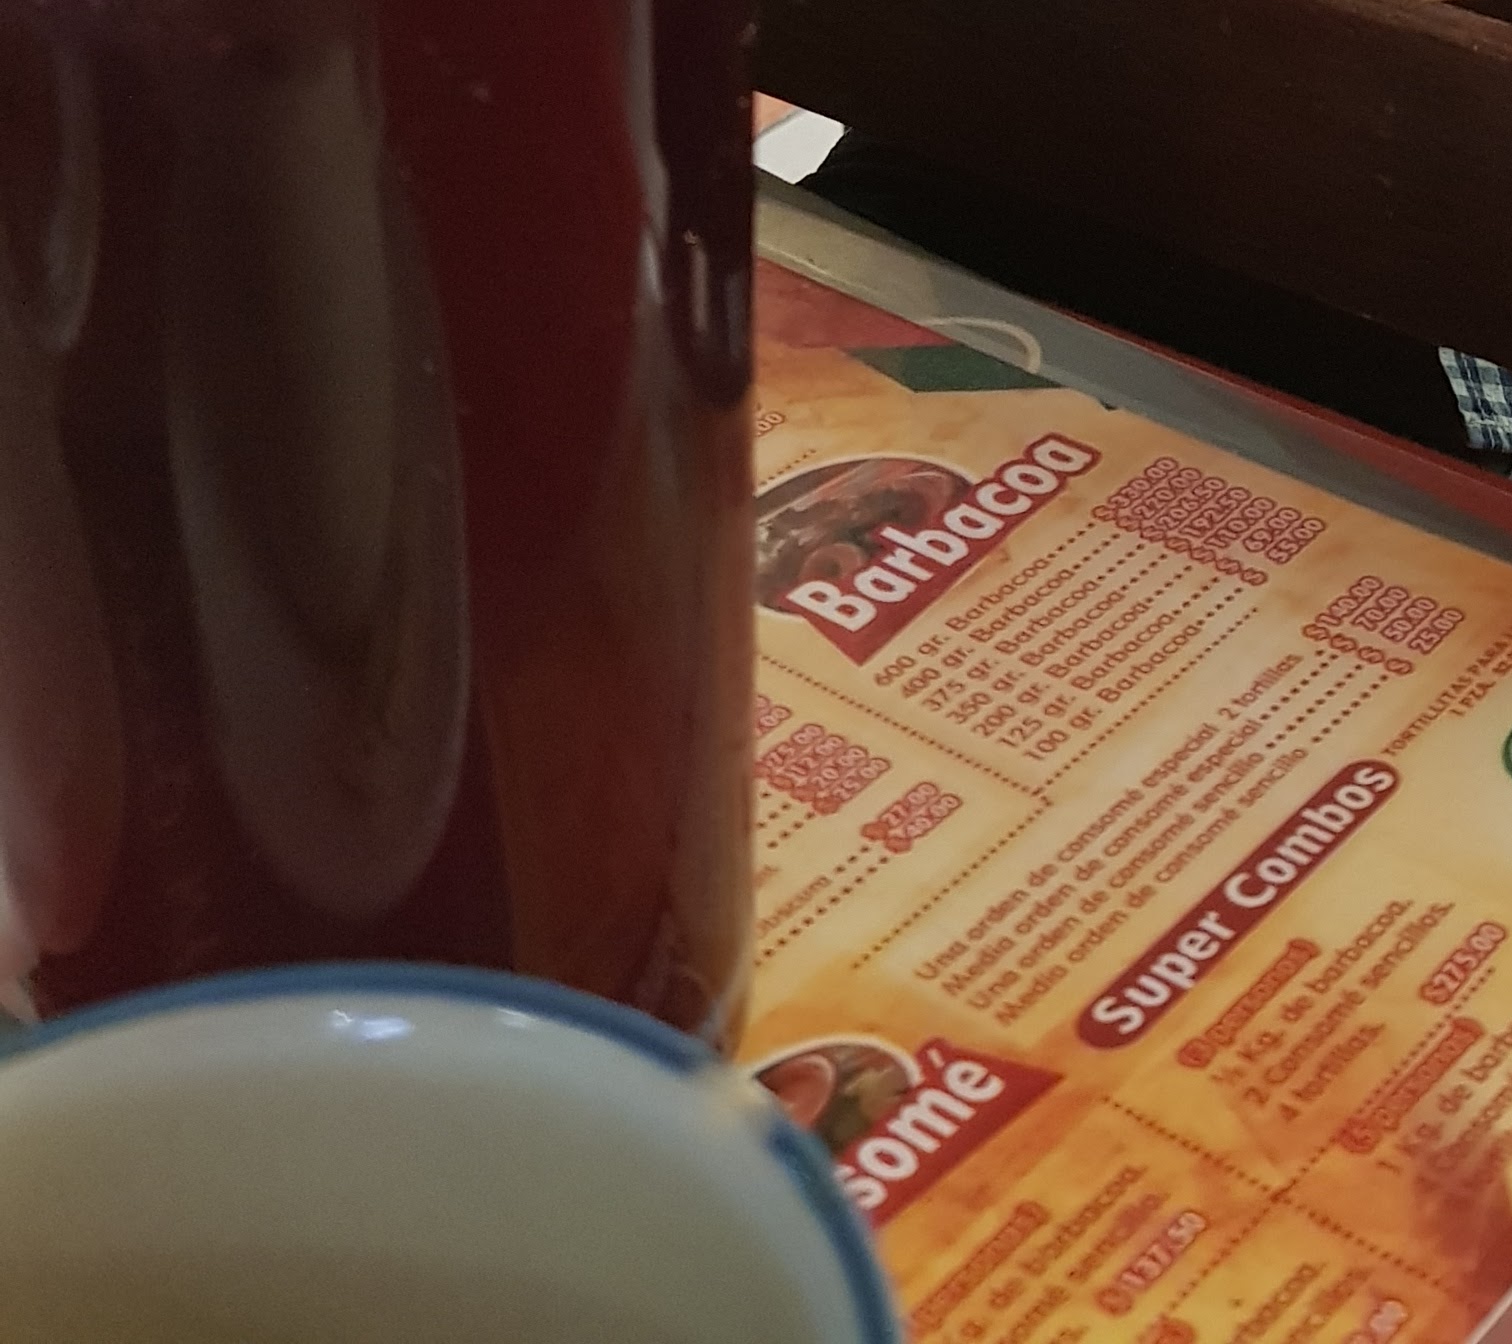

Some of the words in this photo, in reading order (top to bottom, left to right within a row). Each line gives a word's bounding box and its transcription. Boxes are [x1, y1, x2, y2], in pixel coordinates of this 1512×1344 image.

[786, 438, 1094, 632] Barbacoa
[873, 655, 916, 687] 600
[918, 634, 951, 657] gr.
[945, 559, 1049, 632] Barbacoa
[902, 666, 941, 698] 400
[941, 646, 975, 669] gr.
[969, 568, 1075, 643] Barbacoa
[921, 679, 967, 712] 375
[967, 658, 1000, 683] gr.
[995, 579, 1099, 654] Barbacoa
[946, 691, 992, 725] 350
[992, 668, 1027, 693] gr.
[1019, 590, 1125, 668] Barbacoa
[971, 704, 1016, 739] 200
[1016, 682, 1050, 706] gr.
[1044, 602, 1150, 679] Barbacoa
[999, 716, 1044, 749] 125
[1044, 694, 1077, 719] gr.
[1071, 613, 1174, 690] Barbacoa
[1023, 729, 1070, 761] 100
[1070, 704, 1102, 732] gr.
[1097, 625, 1200, 703] Barbacoa
[914, 941, 969, 980] Una
[967, 889, 1029, 941] orden
[1028, 863, 1058, 887] de
[1058, 786, 1144, 863] consomé
[1142, 723, 1219, 789] especial
[1218, 706, 1241, 722] 2
[1231, 654, 1303, 707] tortillas
[942, 936, 1015, 997] Media
[1015, 883, 1076, 935] orden
[1074, 859, 1105, 882] de
[1104, 782, 1188, 858] consomé
[1187, 719, 1263, 783] especial
[1018, 916, 1082, 969] orden
[1079, 890, 1110, 914] de
[1109, 813, 1195, 889] consomé
[1192, 751, 1265, 813] sencillo
[995, 964, 1068, 1027] Media
[1067, 910, 1129, 963] orden
[1125, 884, 1157, 909] de
[1154, 808, 1241, 883] consomé
[1238, 748, 1309, 808] sencillo
[1090, 912, 1236, 1035] Super
[1222, 766, 1397, 910] Combos
[1280, 996, 1314, 1022] de
[834, 1048, 1005, 1209] somé
